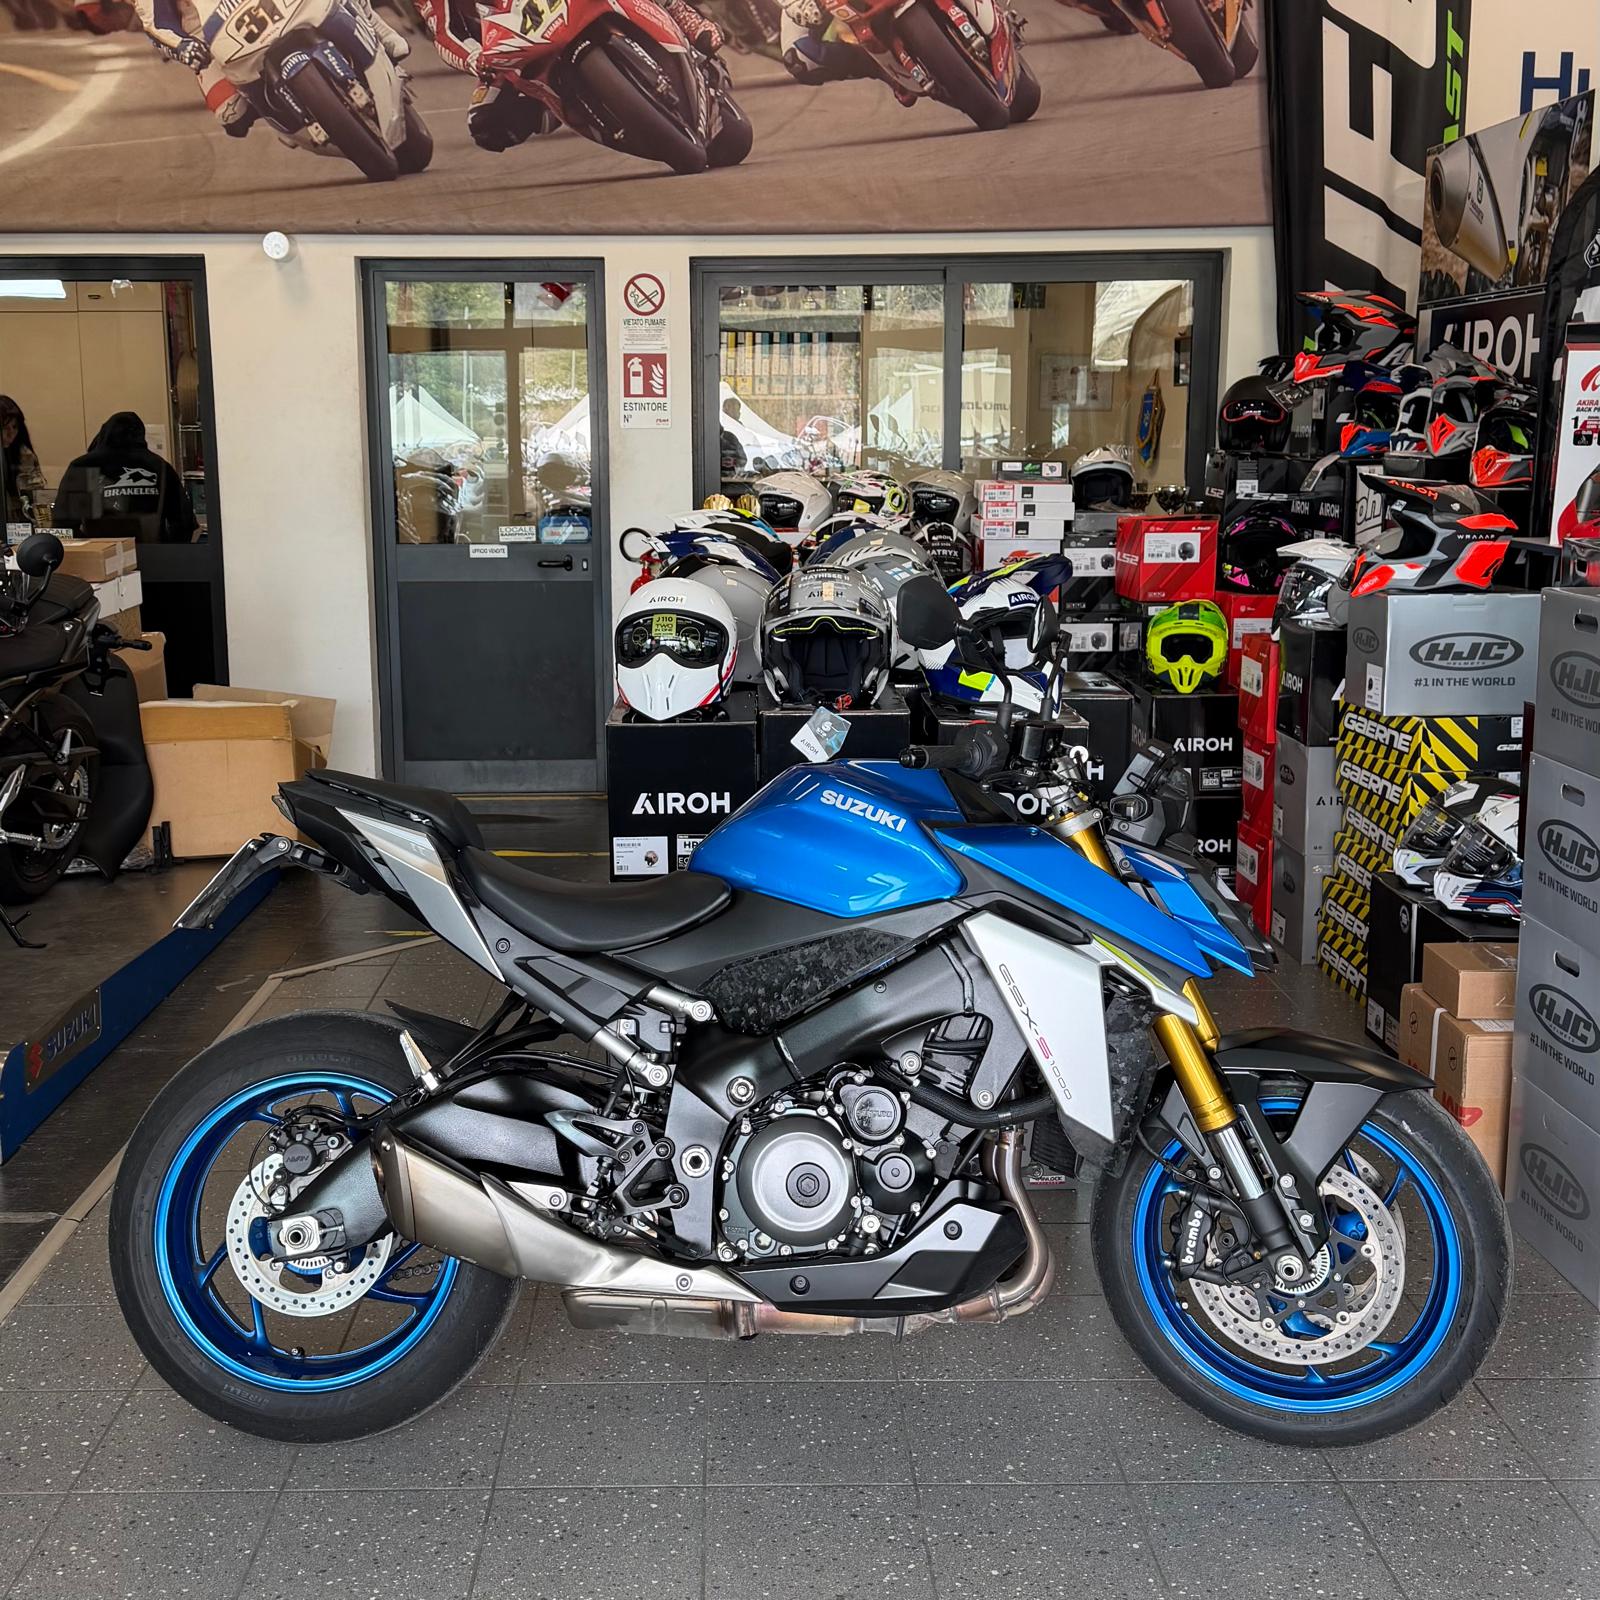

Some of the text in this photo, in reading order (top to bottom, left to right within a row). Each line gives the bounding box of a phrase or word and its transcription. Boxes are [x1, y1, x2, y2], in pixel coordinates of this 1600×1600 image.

[623, 402, 668, 411] ESTINTORE
[1205, 487, 1224, 499] LS2
[1236, 492, 1289, 501] LS2
[1387, 479, 1439, 500] AIROH
[1291, 500, 1309, 515] AIROH
[1319, 502, 1340, 518] AIROH
[1117, 552, 1139, 566] LS2
[1423, 642, 1510, 661] HJC
[1281, 671, 1303, 693] AIROH
[1413, 676, 1516, 687] #1 IN THE WORLD
[1551, 707, 1560, 720] #1
[1561, 711, 1568, 723] IN
[1570, 713, 1584, 729] THE
[801, 738, 819, 755] AIROH
[1173, 737, 1233, 752] AIROH
[632, 791, 731, 814] AIROH
[820, 789, 907, 832] SUZUKI
[1316, 796, 1343, 806] AIR
[1545, 827, 1596, 873] HJC
[1539, 871, 1598, 913] #1 IN THE WORLD
[1537, 991, 1593, 1045] HJC
[48, 1003, 97, 1058] SUZUKI
[1530, 1032, 1594, 1086] #1 IN THE WORLD
[1527, 1151, 1581, 1211] HJC
[1521, 1190, 1530, 1204] #1
[1531, 1199, 1539, 1213] IN
[1540, 1204, 1555, 1226] THE
[1555, 1218, 1584, 1252] WORLD
[1181, 1210, 1203, 1264] brembo
